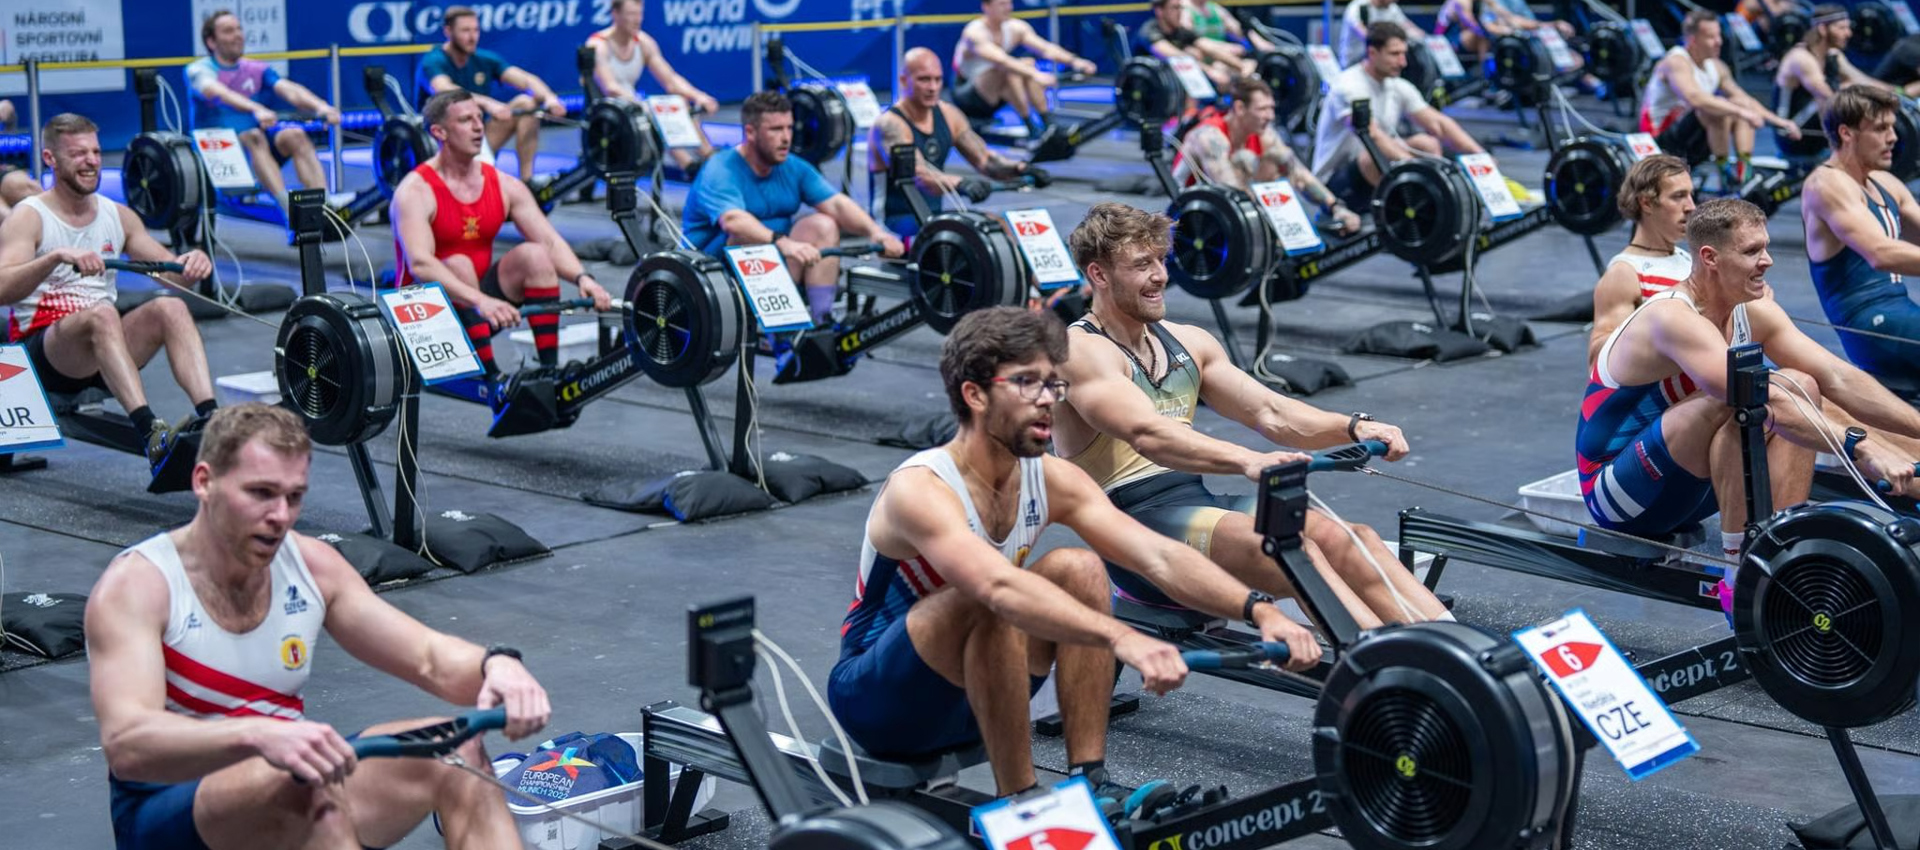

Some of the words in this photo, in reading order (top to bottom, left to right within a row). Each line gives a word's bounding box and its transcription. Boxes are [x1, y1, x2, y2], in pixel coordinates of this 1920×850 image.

[15, 7, 85, 27] NÁRODNÍ
[415, 0, 581, 34] cncept
[663, 0, 746, 26] world
[16, 28, 103, 47] SPORTOVNÍ
[211, 162, 240, 178] CZE
[1020, 221, 1040, 236] 21
[745, 259, 766, 275] 20
[1033, 252, 1064, 269] ARG
[404, 304, 428, 321] 19
[757, 294, 794, 312] GBR
[860, 307, 911, 342] concept
[410, 334, 433, 346] Fuller
[415, 341, 459, 364] GBR
[580, 354, 633, 392] concept
[1557, 644, 1584, 672] 6
[1720, 650, 1737, 672] 2
[1596, 700, 1651, 741] CZE
[519, 779, 571, 794] CHAMPIONSHIPS
[521, 770, 576, 789] EUROPEAN
[517, 785, 547, 796] MUNICH
[547, 790, 569, 801] 2022
[1187, 797, 1306, 850] concept
[1308, 789, 1327, 815] 2
